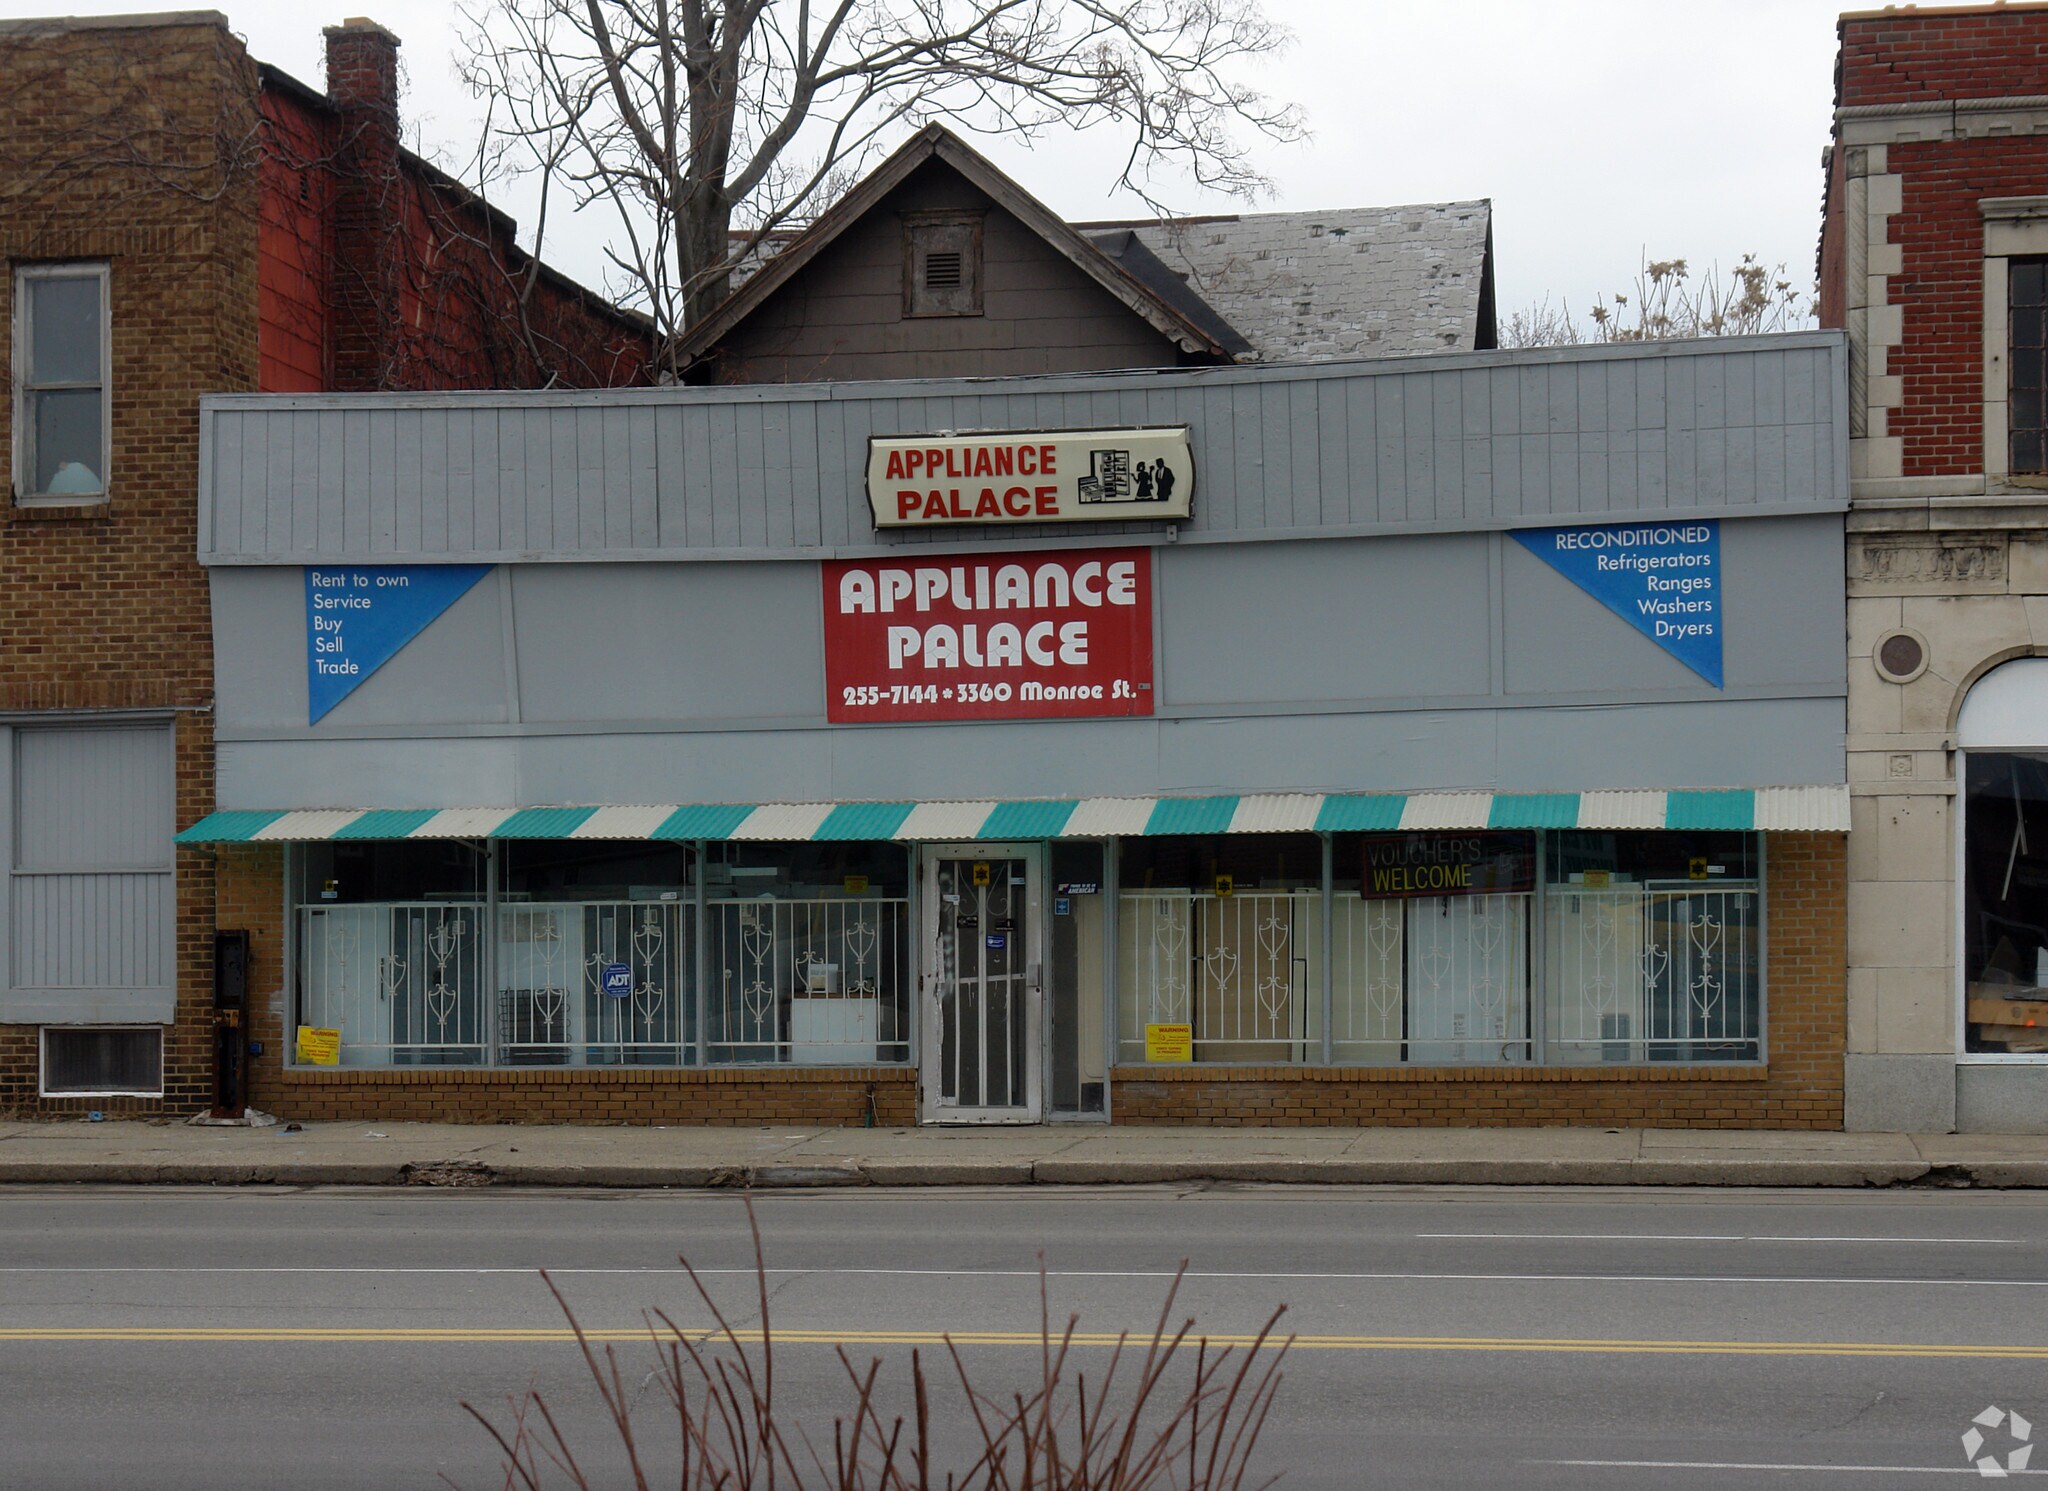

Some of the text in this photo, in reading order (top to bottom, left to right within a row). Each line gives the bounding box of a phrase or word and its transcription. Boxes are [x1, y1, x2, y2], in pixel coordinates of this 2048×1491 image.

[886, 445, 1057, 480] APPLIANCE
[897, 486, 1060, 519] PALACE
[1556, 526, 1711, 550] RECONDITIONED
[1597, 553, 1711, 573] Refrigerators
[312, 572, 409, 587] Rent to own
[839, 561, 1136, 614] APPLIANCE
[1647, 576, 1712, 594] Ranges
[313, 593, 371, 609] Service
[1637, 596, 1712, 615] Washers
[314, 616, 343, 634] Buy
[1655, 620, 1713, 640] Dryers
[315, 636, 343, 653] Sell
[887, 620, 1089, 669] PALACE
[316, 659, 359, 675] Trade
[1020, 681, 1103, 701] Monroe
[1112, 679, 1137, 698] St.
[1367, 839, 1481, 866] VOUCHER'S
[1373, 863, 1473, 892] WELCOME
[608, 974, 630, 986] ADT
